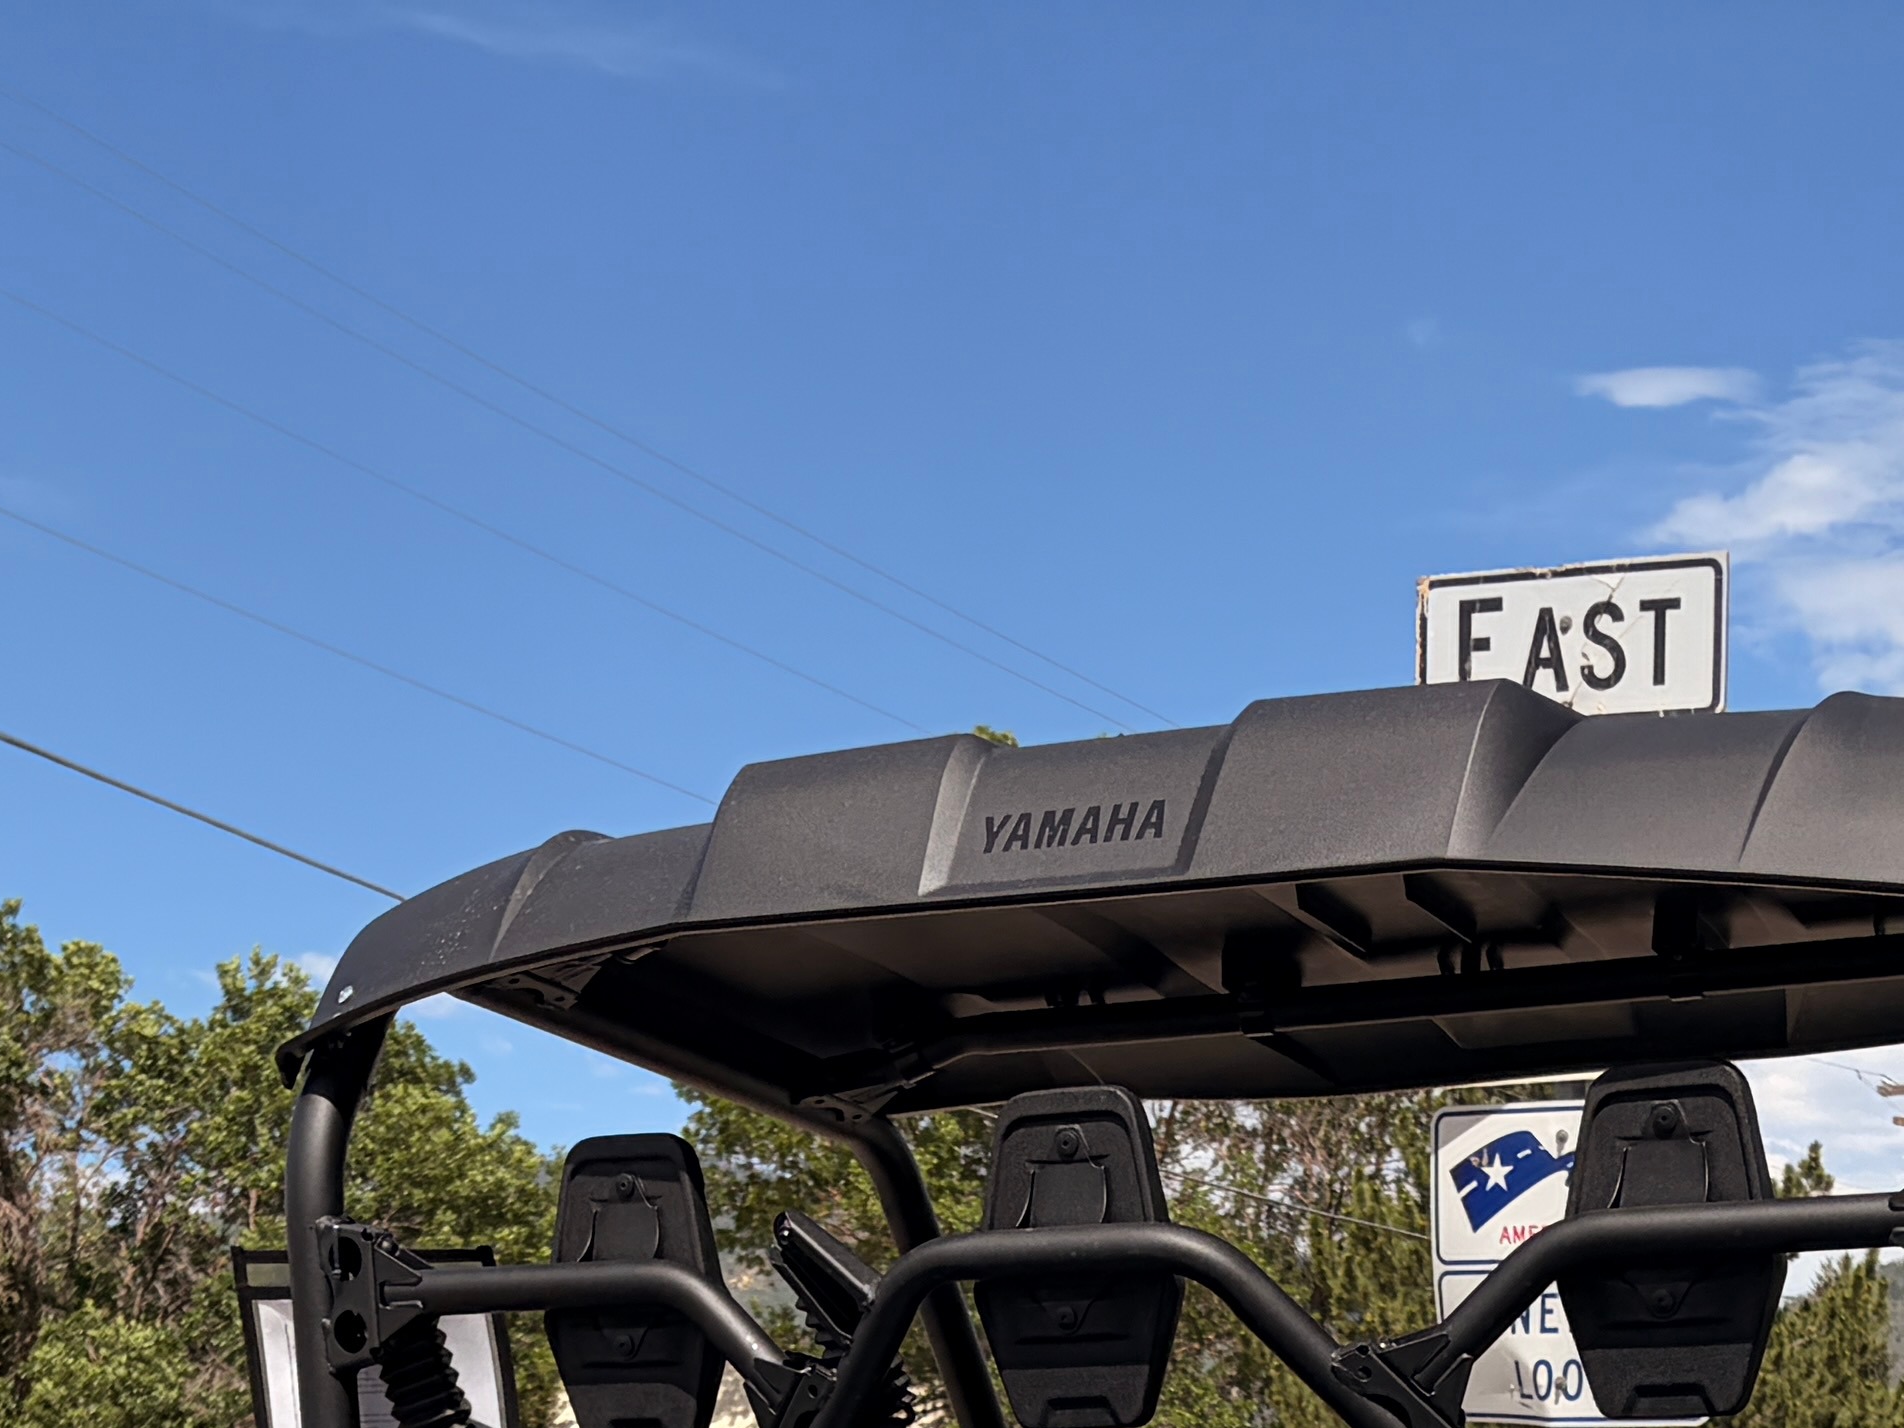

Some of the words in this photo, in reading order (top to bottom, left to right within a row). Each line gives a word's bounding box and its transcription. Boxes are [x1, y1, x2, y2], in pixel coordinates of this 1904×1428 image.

[1458, 595, 1682, 692] EAST
[983, 799, 1166, 854] YAMAHA
[1511, 1293, 1564, 1335] NE
[1514, 1358, 1584, 1402] LOO
